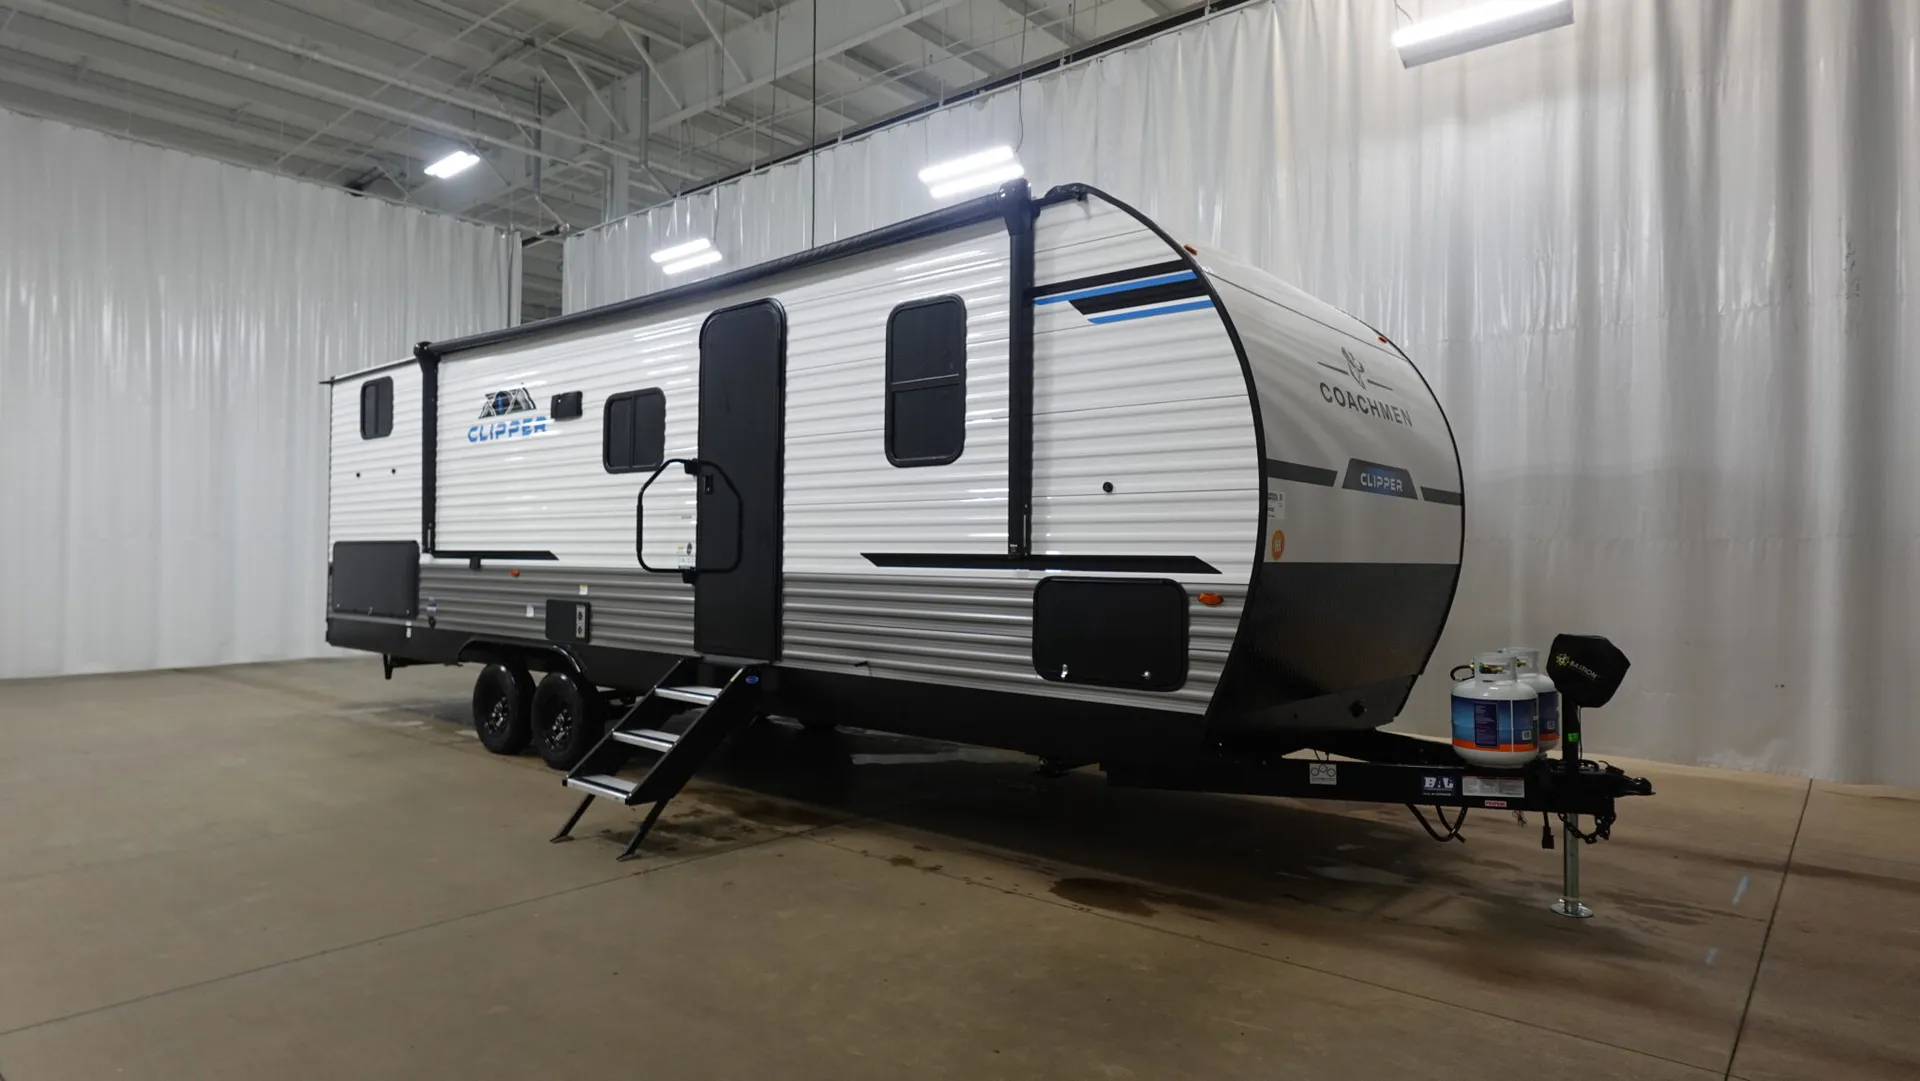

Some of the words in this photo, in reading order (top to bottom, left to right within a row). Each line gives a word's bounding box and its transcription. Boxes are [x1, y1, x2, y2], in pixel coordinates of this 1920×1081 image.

[1319, 382, 1413, 427] COACHMEN
[467, 416, 547, 442] CLIPPER
[1360, 472, 1403, 492] CLIPPER
